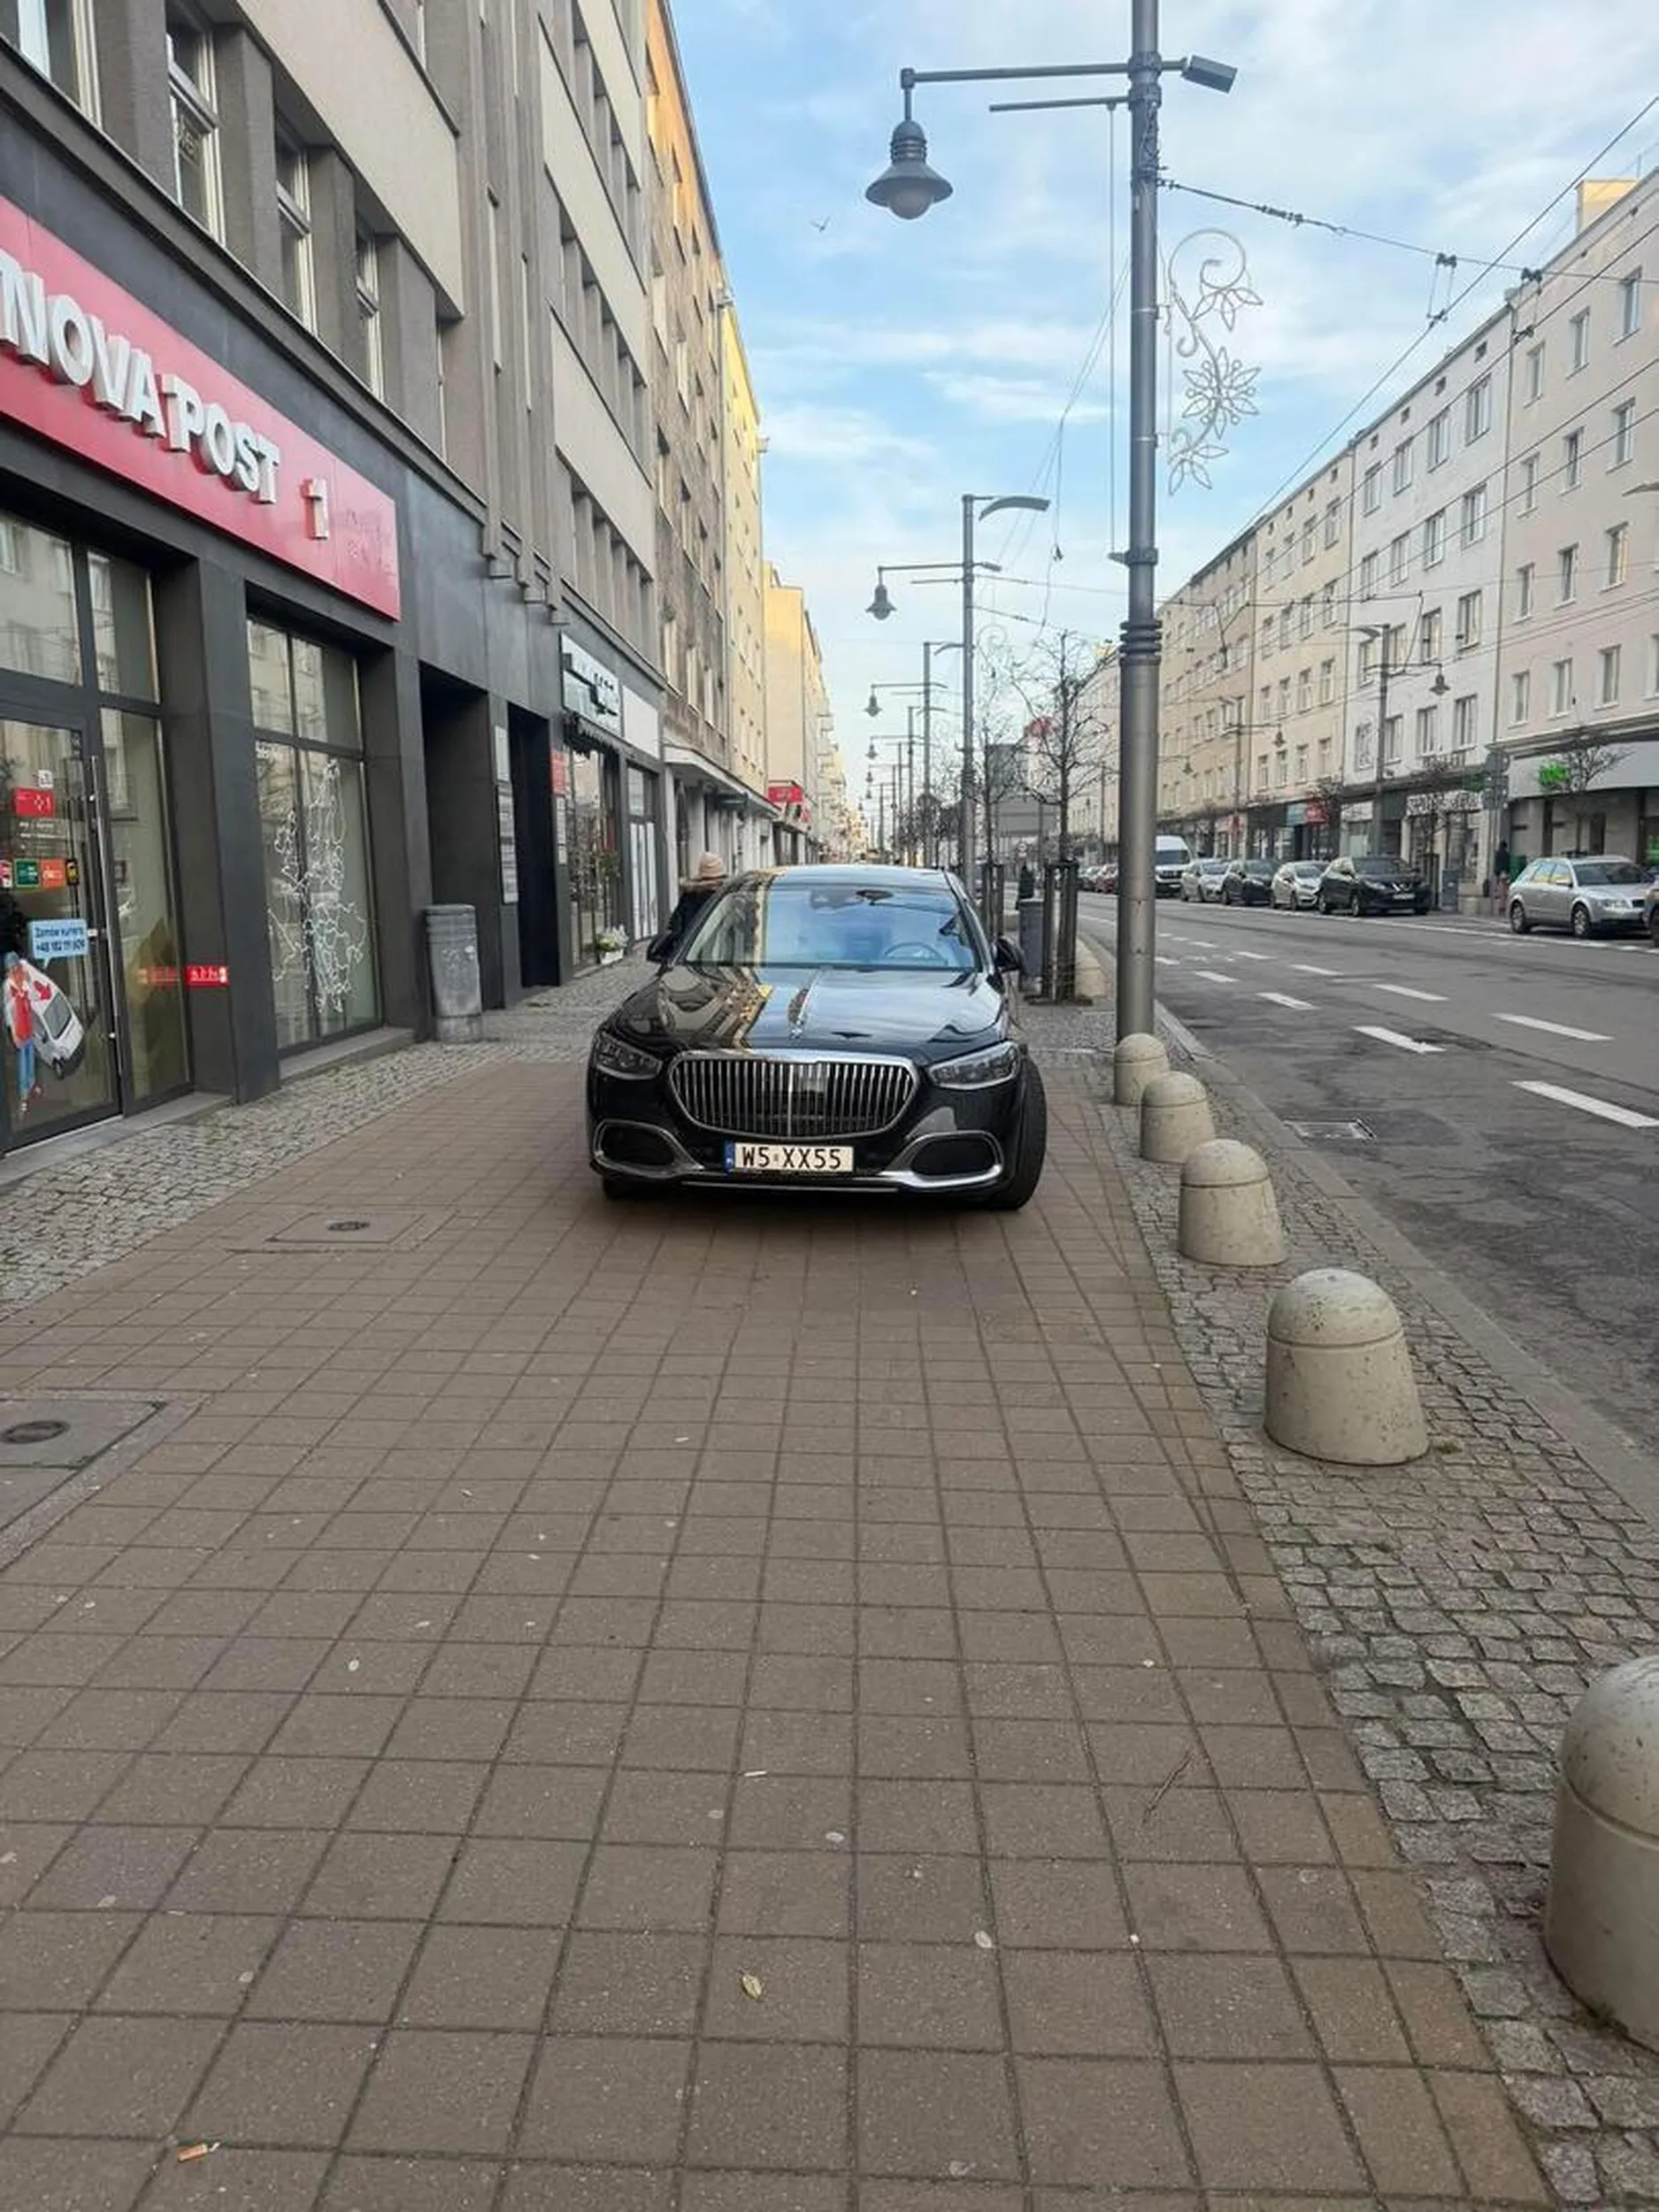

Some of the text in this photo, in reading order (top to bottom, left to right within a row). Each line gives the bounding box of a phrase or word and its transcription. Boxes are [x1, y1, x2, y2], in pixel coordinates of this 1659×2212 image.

[0, 250, 165, 438] NOVA
[158, 373, 280, 504] POST
[783, 1148, 841, 1170] XX55
